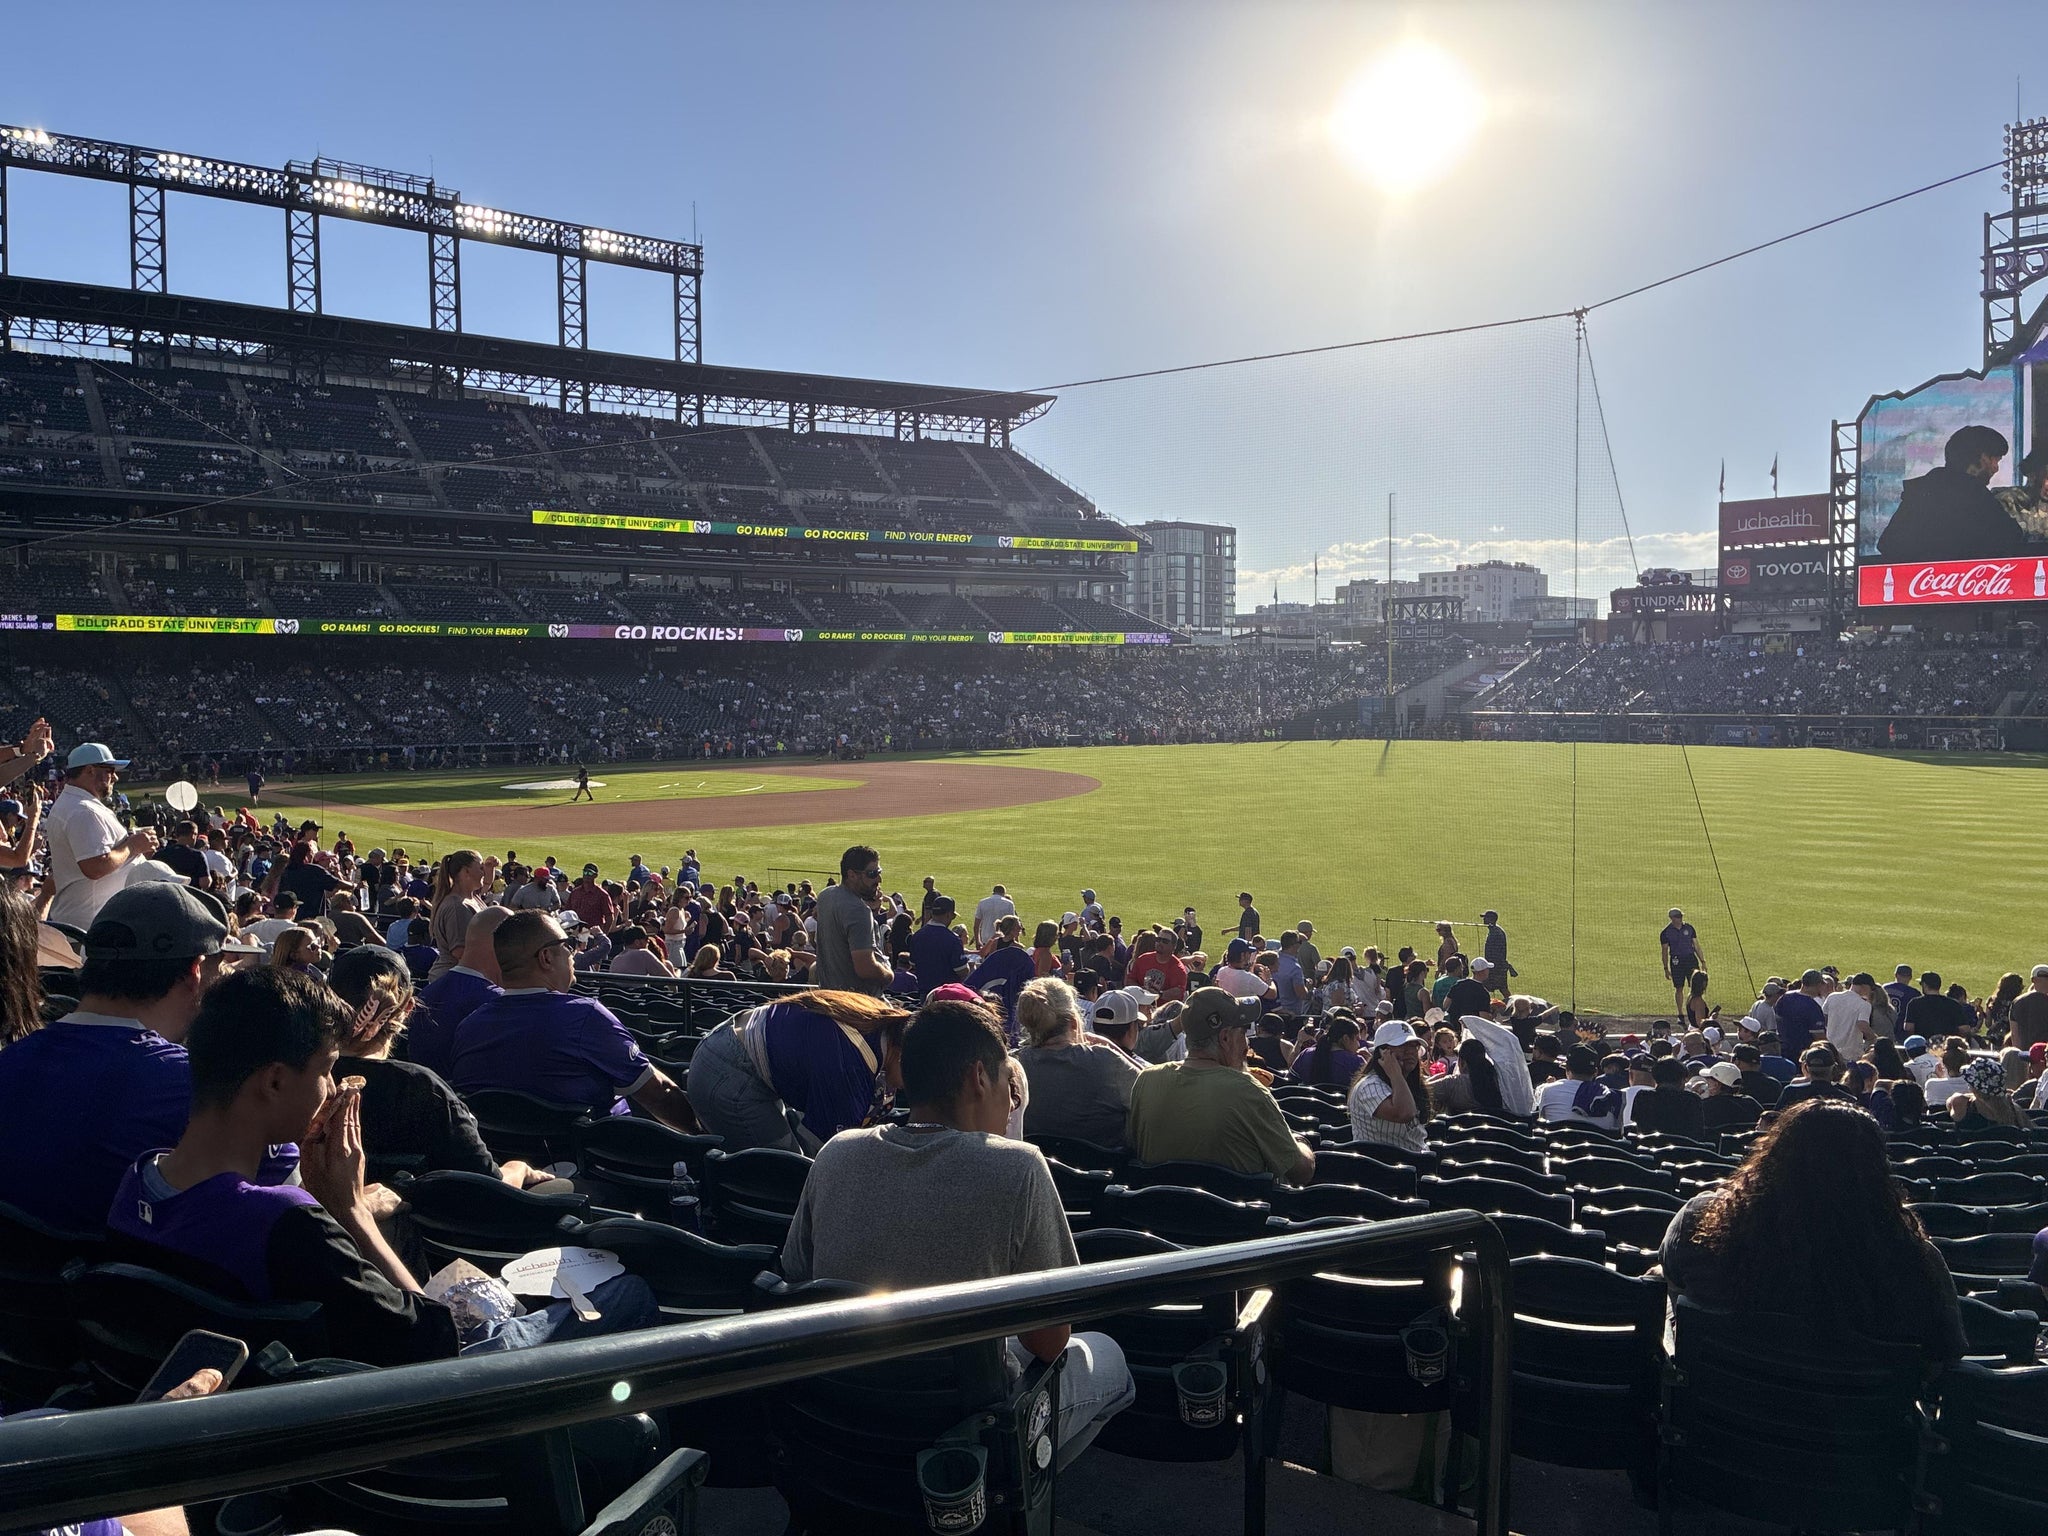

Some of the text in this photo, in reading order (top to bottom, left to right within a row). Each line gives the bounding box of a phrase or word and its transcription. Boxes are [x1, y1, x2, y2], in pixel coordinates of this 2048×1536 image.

[551, 514, 677, 529] COLORADO STATE UNIVERSITY
[1737, 508, 1813, 532] uchealth
[736, 525, 788, 537] GO RAMS!
[804, 529, 869, 541] GO ROCKIES!
[884, 530, 973, 544] FIND YOUR ENERGY
[1027, 538, 1125, 550] COLORADO STATE UNIVERSITY
[1756, 561, 1826, 577] TOYOTA
[1632, 595, 1687, 607] TUNDRA
[77, 618, 258, 630] COLORADO STATE UNIVERSITY
[320, 623, 371, 633] GO RAMS!
[379, 624, 440, 634] GO ROCKIES!
[447, 626, 530, 637] FIND YOUR ENERGY
[614, 625, 744, 641] GO ROCKIES!
[818, 632, 856, 640] GO RAMS!
[861, 632, 907, 641] GO ROCKIES!
[911, 634, 974, 643] FIND YOUR ENERGY
[1013, 633, 1052, 642] COLORADO
[1052, 634, 1074, 643] STATE
[1075, 634, 1116, 643] UNIVERSITY
[515, 1257, 573, 1273] uchealth
